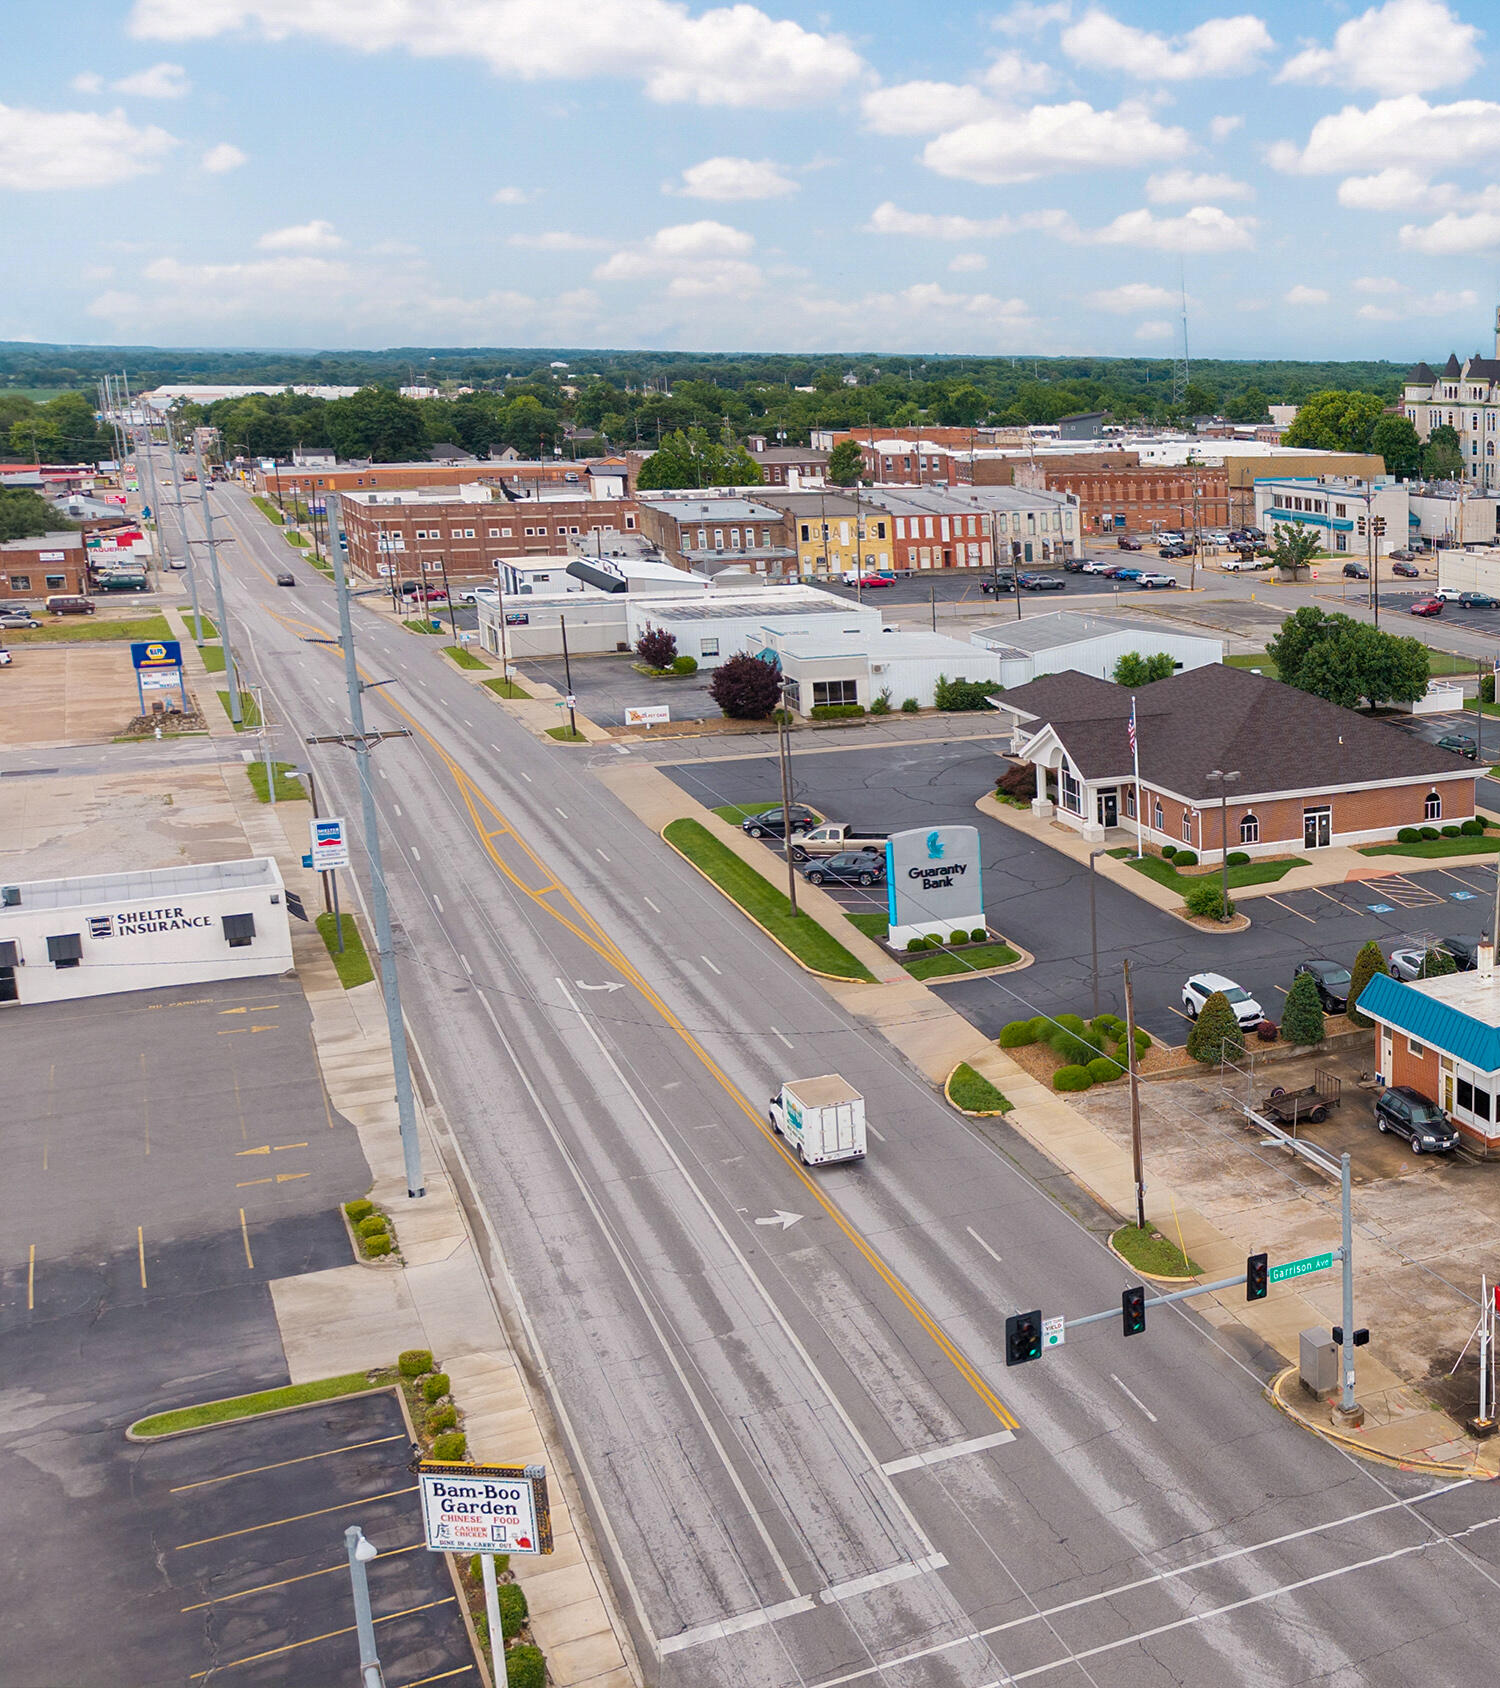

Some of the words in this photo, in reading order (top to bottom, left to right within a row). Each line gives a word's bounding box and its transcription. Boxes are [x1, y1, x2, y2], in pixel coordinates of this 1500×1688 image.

[908, 863, 968, 880] Guaranty
[922, 875, 954, 890] Bank
[117, 907, 184, 925] SHELTER
[119, 916, 212, 936] INSURANCE
[1273, 1262, 1312, 1280] Garrison
[1315, 1259, 1329, 1268] Ave
[1045, 1323, 1061, 1331] YIELD
[432, 1482, 520, 1500] Bam-Boo
[441, 1498, 518, 1515] Garden
[440, 1514, 482, 1524] CHINESE
[493, 1516, 520, 1525] FOOD
